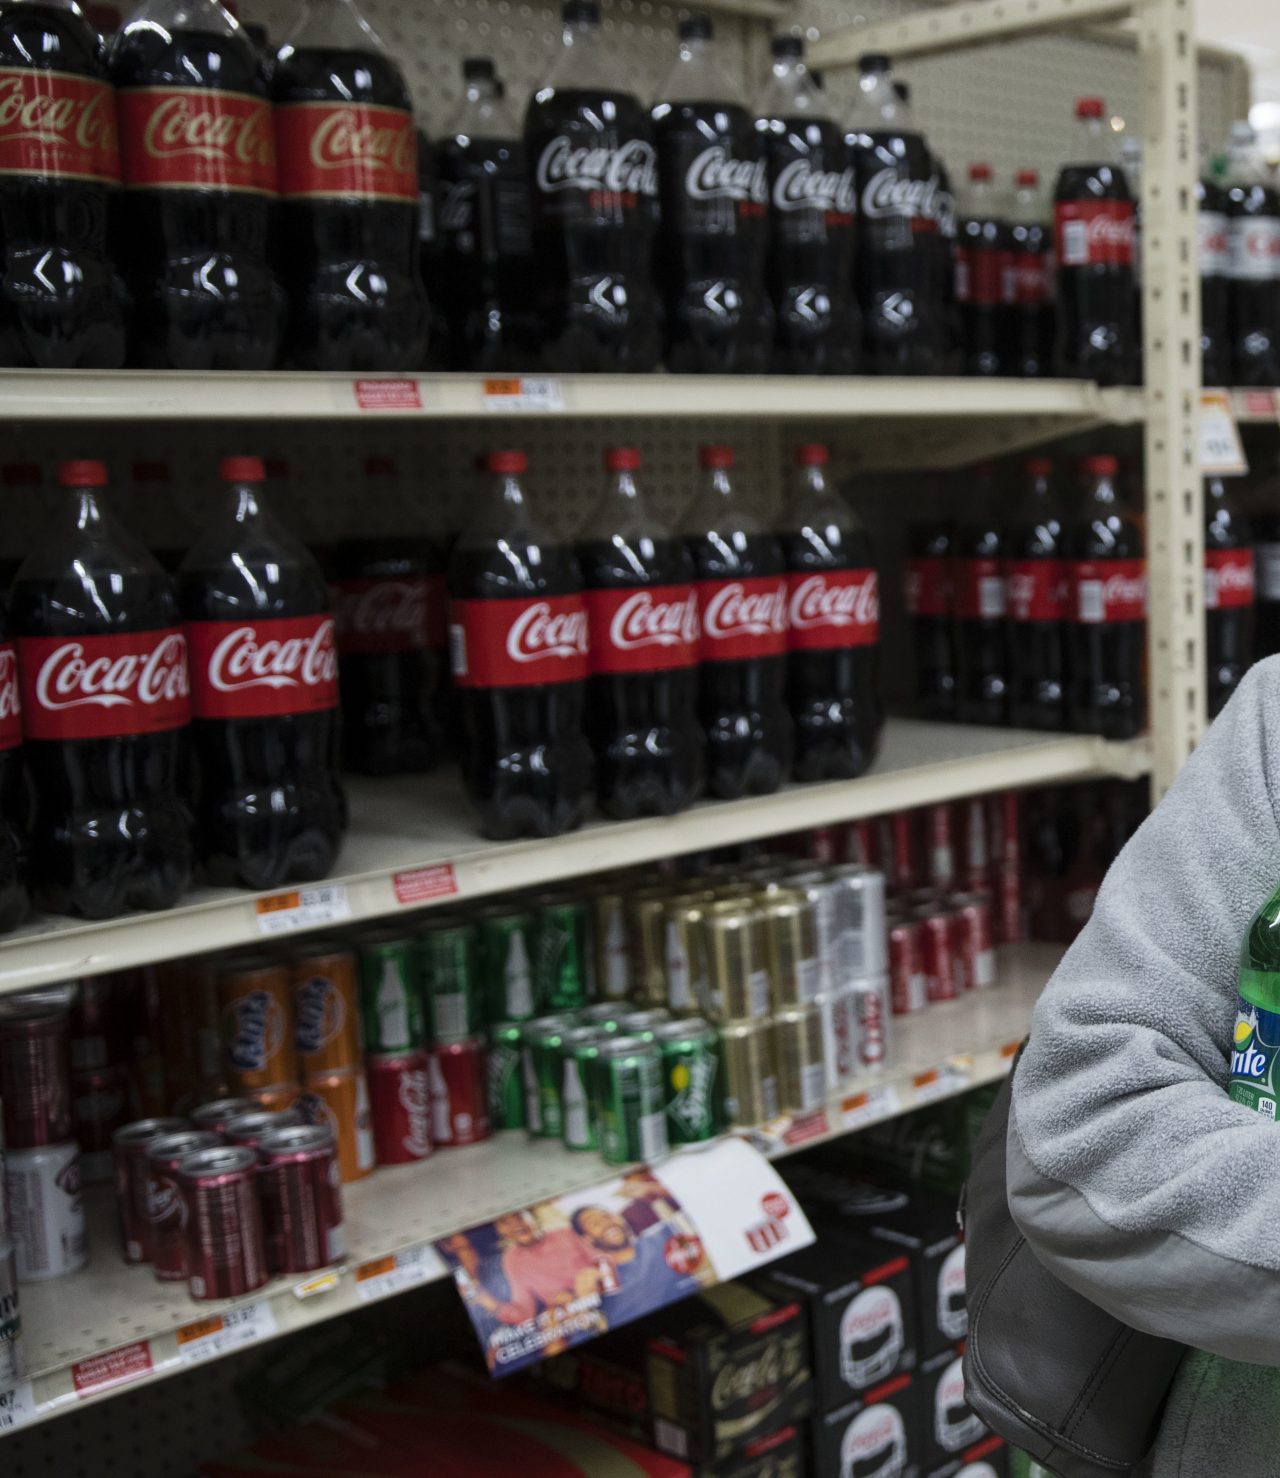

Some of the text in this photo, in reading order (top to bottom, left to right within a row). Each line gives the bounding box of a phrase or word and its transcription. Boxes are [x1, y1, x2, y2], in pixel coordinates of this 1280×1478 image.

[144, 96, 274, 164] Coca-C
[37, 634, 189, 710] Coca-Col
[208, 619, 337, 692] Coca-Co
[1231, 1041, 1265, 1077] rite
[1262, 1100, 1273, 1110] 140
